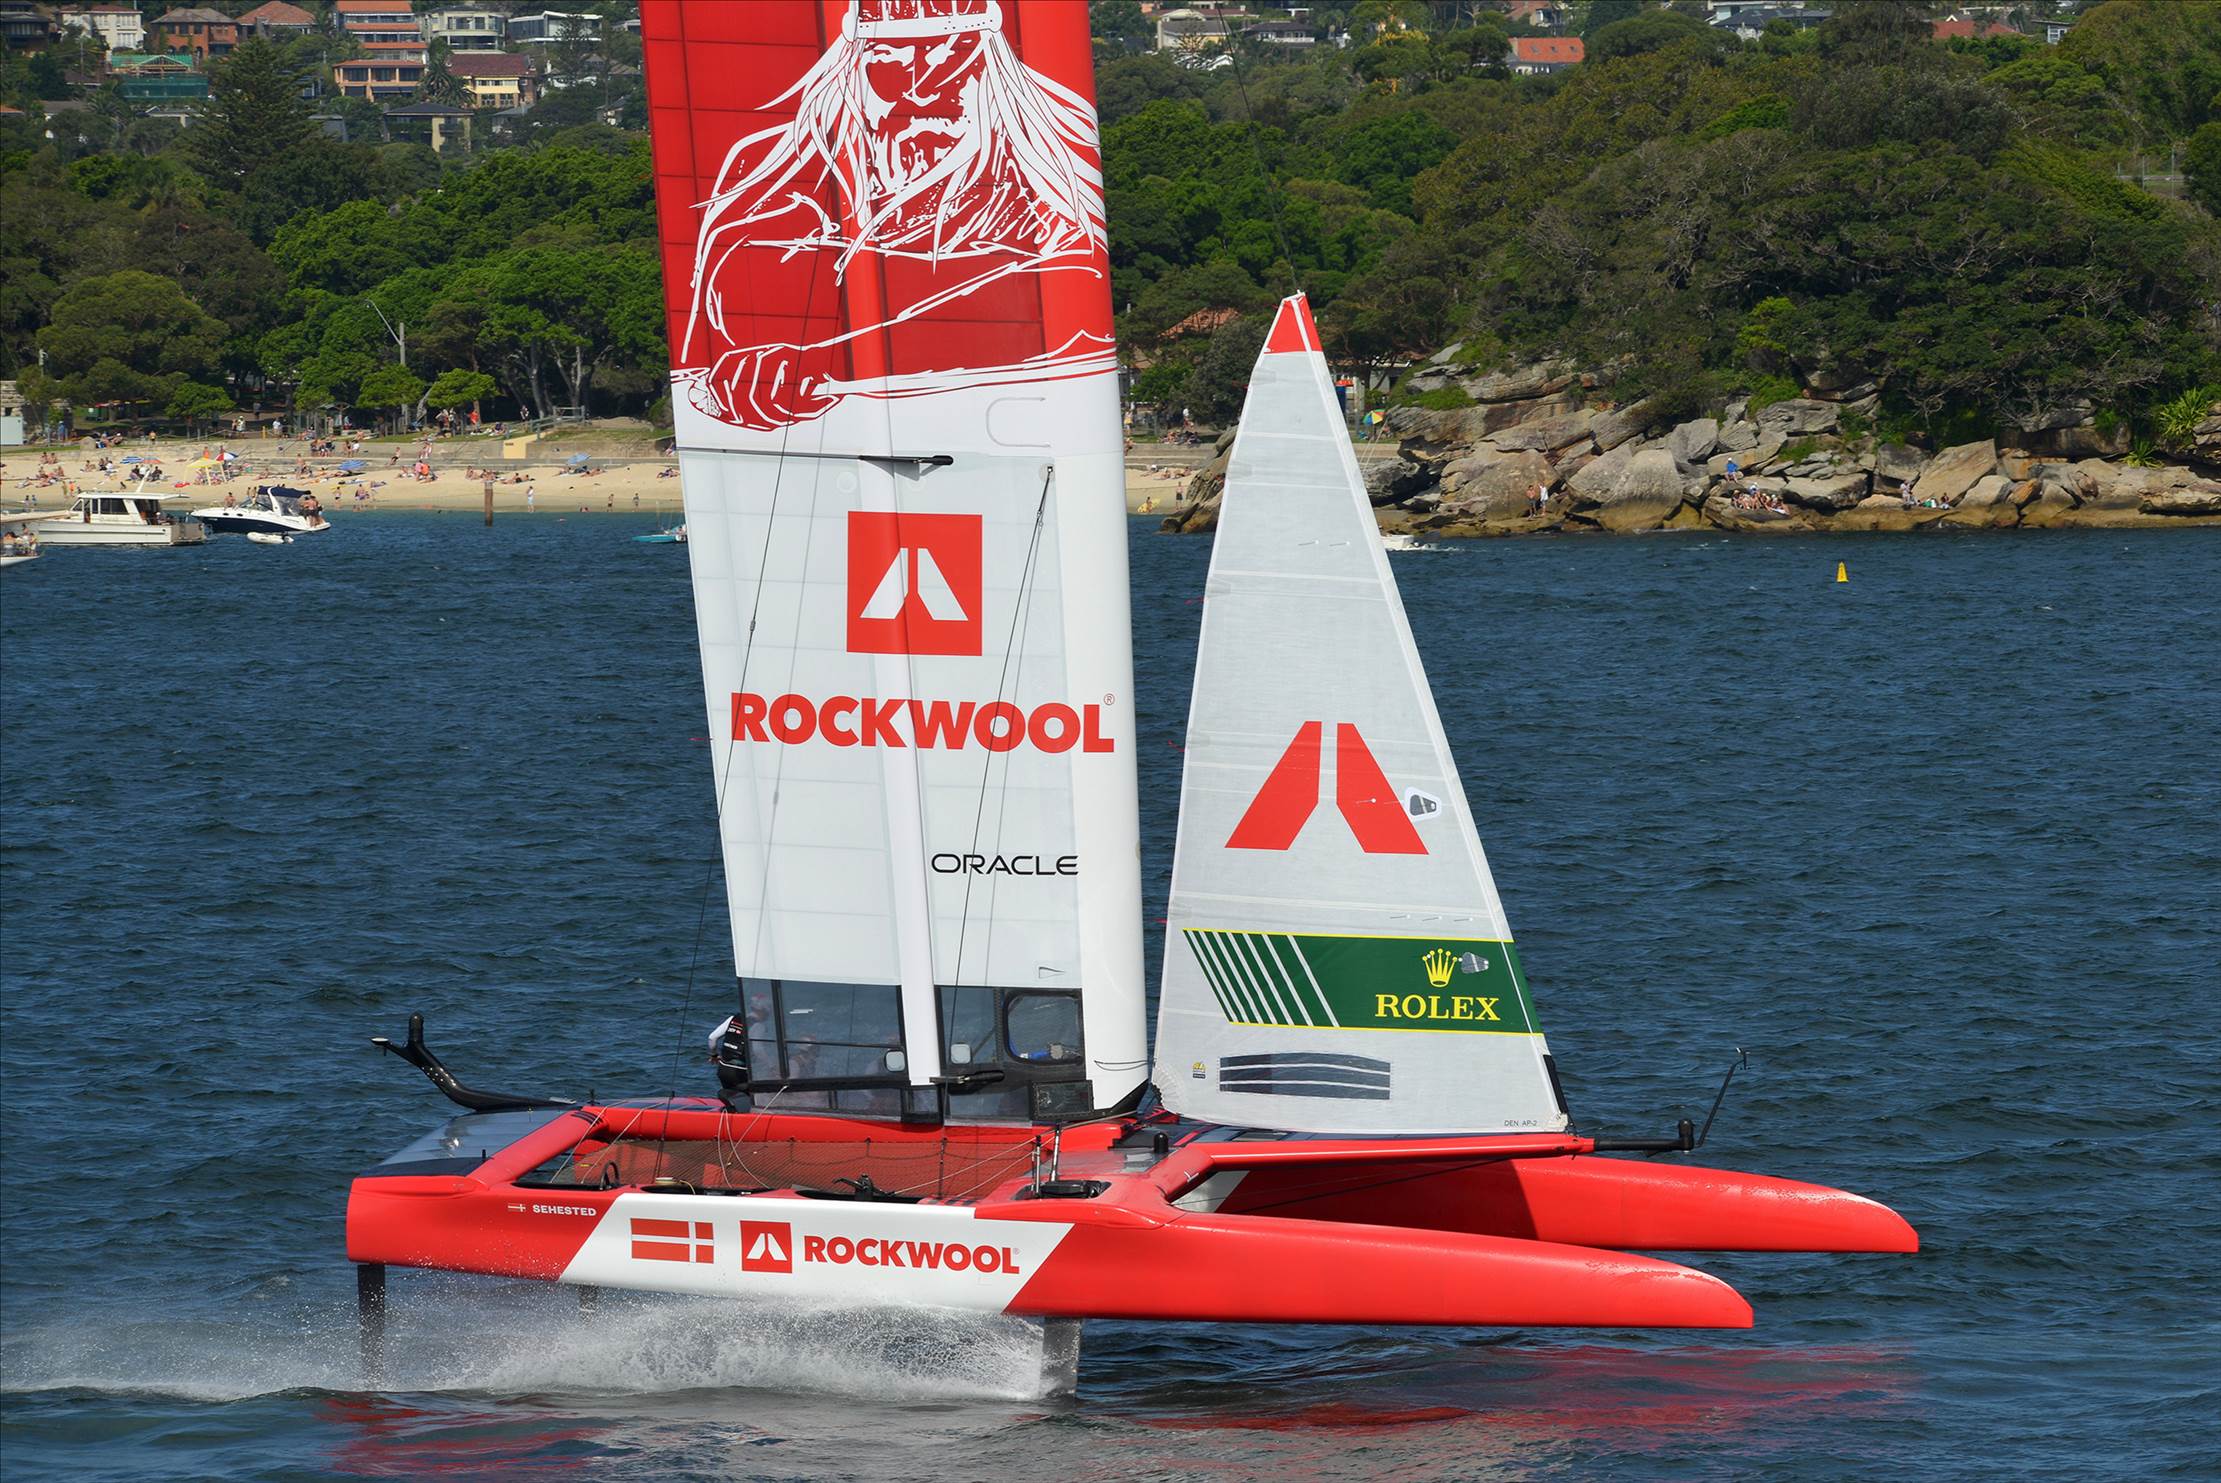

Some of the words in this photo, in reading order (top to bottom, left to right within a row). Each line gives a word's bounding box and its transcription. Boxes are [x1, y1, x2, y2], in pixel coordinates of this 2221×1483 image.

[931, 853, 1079, 876] ORACLE
[1375, 994, 1501, 1021] ROLEX
[532, 1204, 597, 1216] SEHESTED
